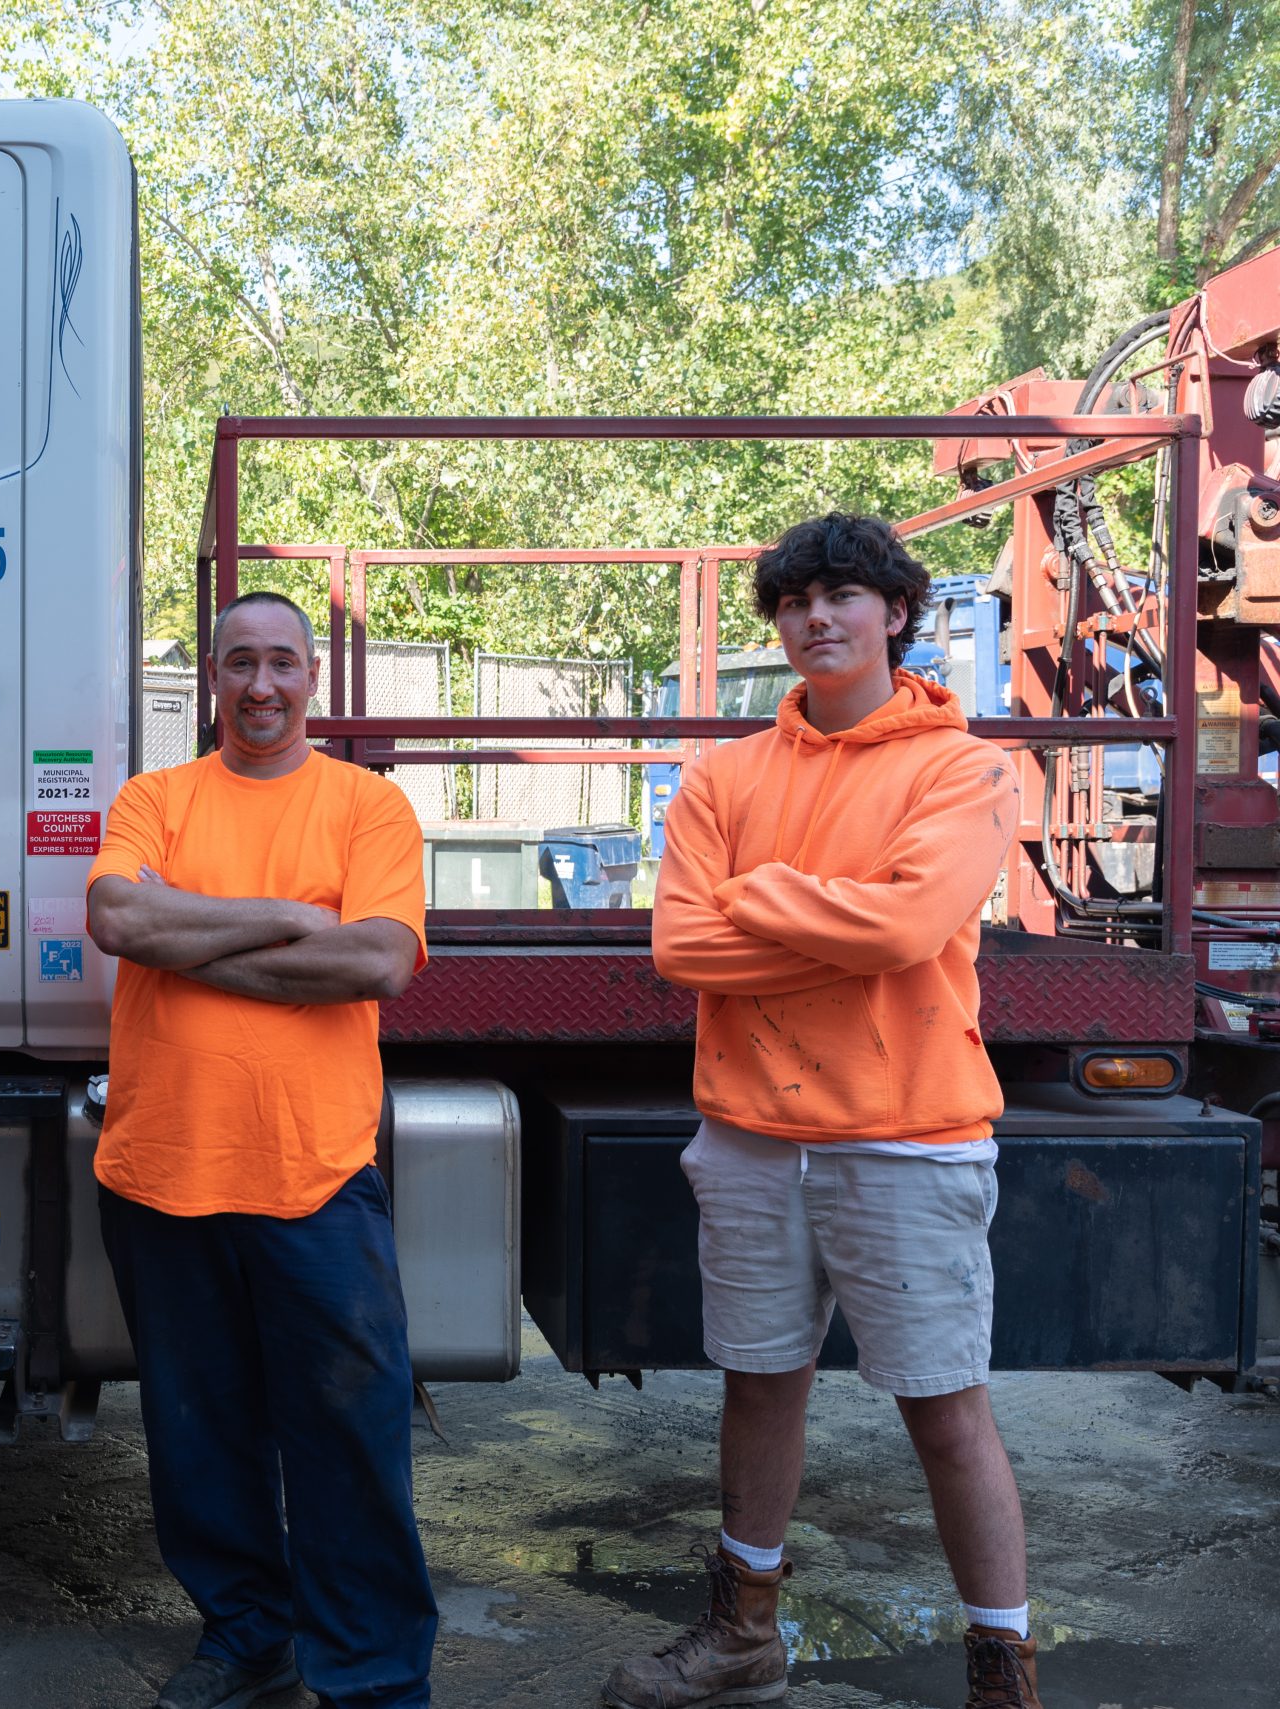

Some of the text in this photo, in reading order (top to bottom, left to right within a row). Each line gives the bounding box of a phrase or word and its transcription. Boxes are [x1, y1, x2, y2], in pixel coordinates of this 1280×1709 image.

[37, 788, 90, 799] 2021-22
[37, 814, 91, 823] DUTCHESS
[43, 824, 85, 833] COUNTY
[471, 858, 490, 894] L
